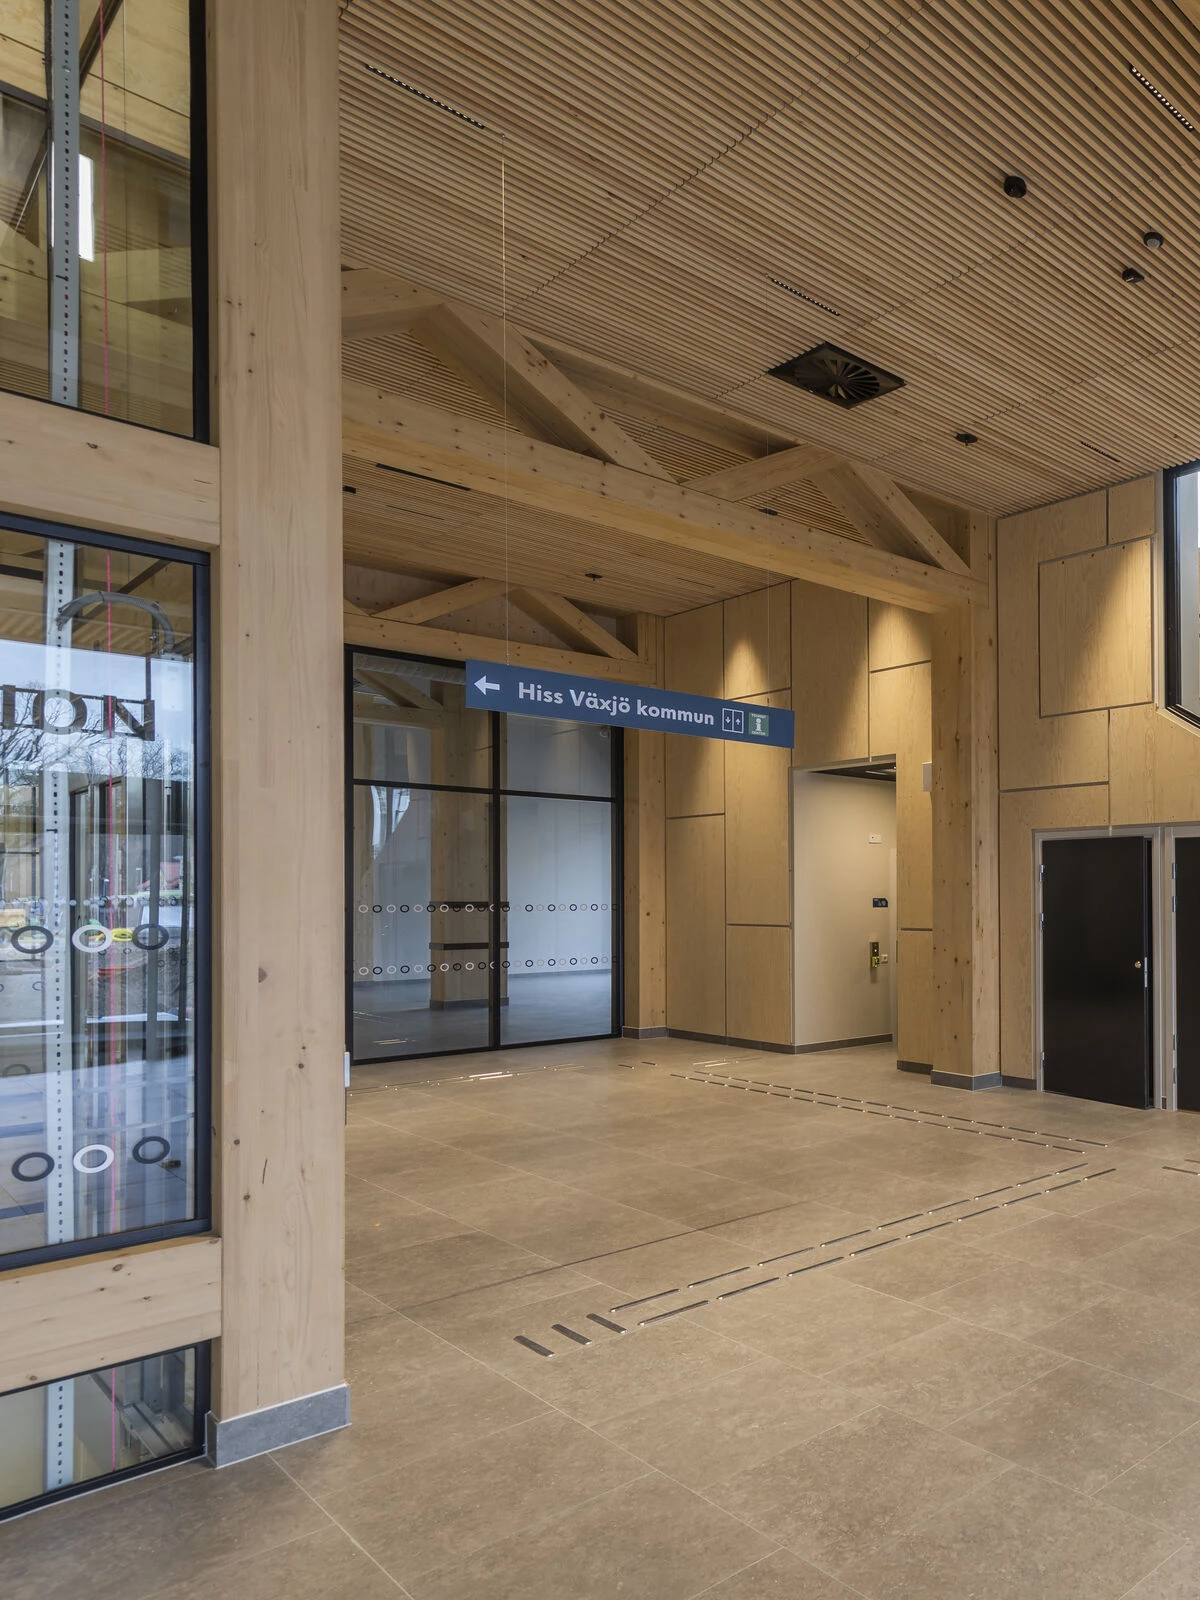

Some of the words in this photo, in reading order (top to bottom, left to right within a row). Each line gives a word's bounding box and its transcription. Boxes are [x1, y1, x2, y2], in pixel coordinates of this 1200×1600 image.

[518, 682, 564, 705] Hiss
[569, 689, 631, 717] Växjö
[636, 699, 715, 726] kommun
